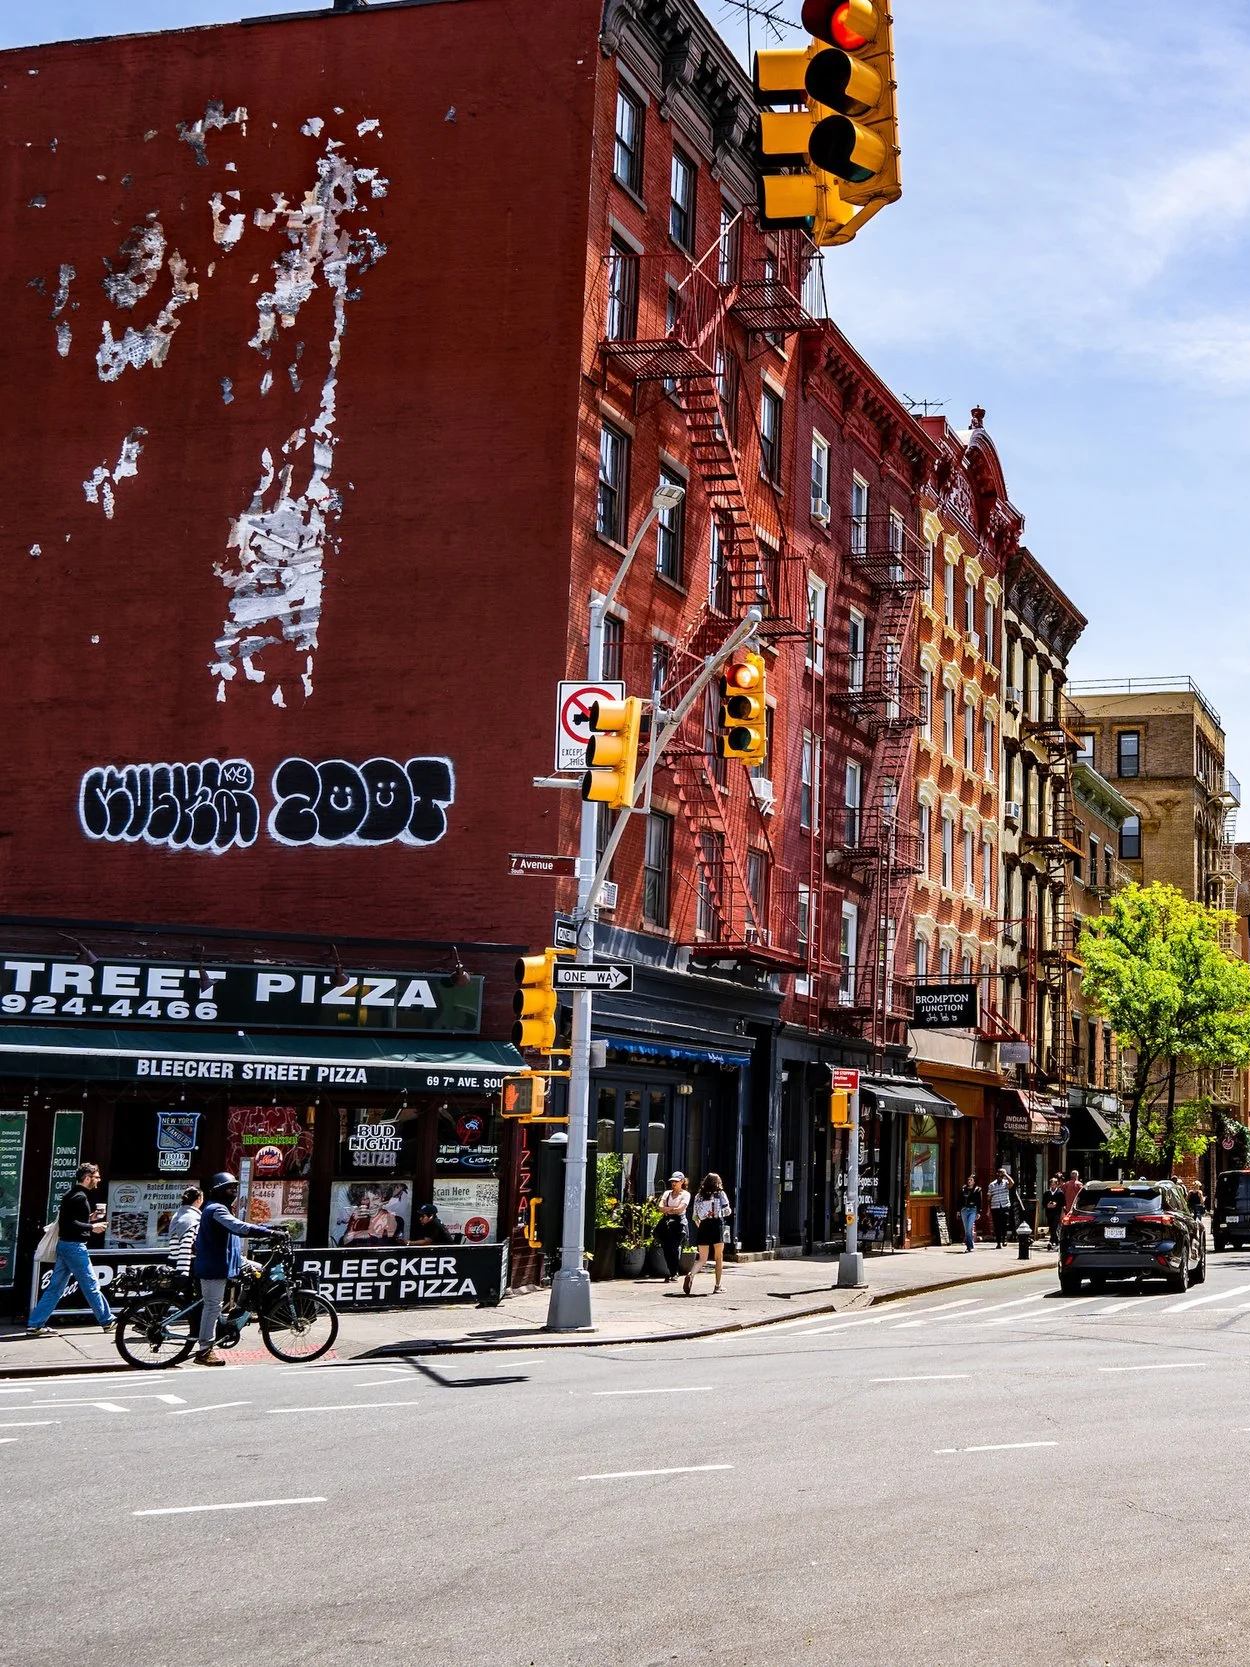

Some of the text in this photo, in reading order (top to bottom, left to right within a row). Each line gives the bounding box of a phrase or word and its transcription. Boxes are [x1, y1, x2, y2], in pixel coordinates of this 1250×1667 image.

[561, 748, 583, 756] EXCEPT
[570, 758, 585, 766] THIS
[223, 766, 248, 784] KYS
[510, 858, 554, 870] 7 Avenue
[559, 928, 571, 941] ONE
[563, 971, 621, 983] ONE WAY
[255, 972, 438, 1009] PIZZA
[915, 994, 969, 1004] BROMPTON
[1, 993, 219, 1020] 924-4466
[921, 1004, 964, 1012] JUNCTION
[137, 1058, 368, 1084] BLEECKER STREET PIZZA
[426, 1076, 440, 1087] 69
[457, 1077, 480, 1088] AVE.
[483, 1078, 504, 1089] SOU
[1005, 1115, 1028, 1123] INDIAN
[357, 1124, 396, 1137] BUD
[1003, 1122, 1029, 1131] CUISINE
[165, 1126, 192, 1147] RANGERS
[349, 1137, 403, 1151] LIGHT
[56, 1146, 77, 1155] DINING
[53, 1158, 77, 1167] ROOM &
[352, 1151, 397, 1166] SELTZER
[468, 1156, 499, 1164] LIGHT
[52, 1170, 77, 1178] COUNTER
[517, 1127, 533, 1214] IZZA
[55, 1182, 73, 1190] OPEN
[147, 1183, 164, 1191] Rated
[432, 1186, 470, 1197] Scan Here
[54, 1193, 65, 1201] NE
[157, 1202, 181, 1210] TripAdvi
[302, 1256, 457, 1279] BLEECKER
[318, 1278, 478, 1301] REET PIZZA
